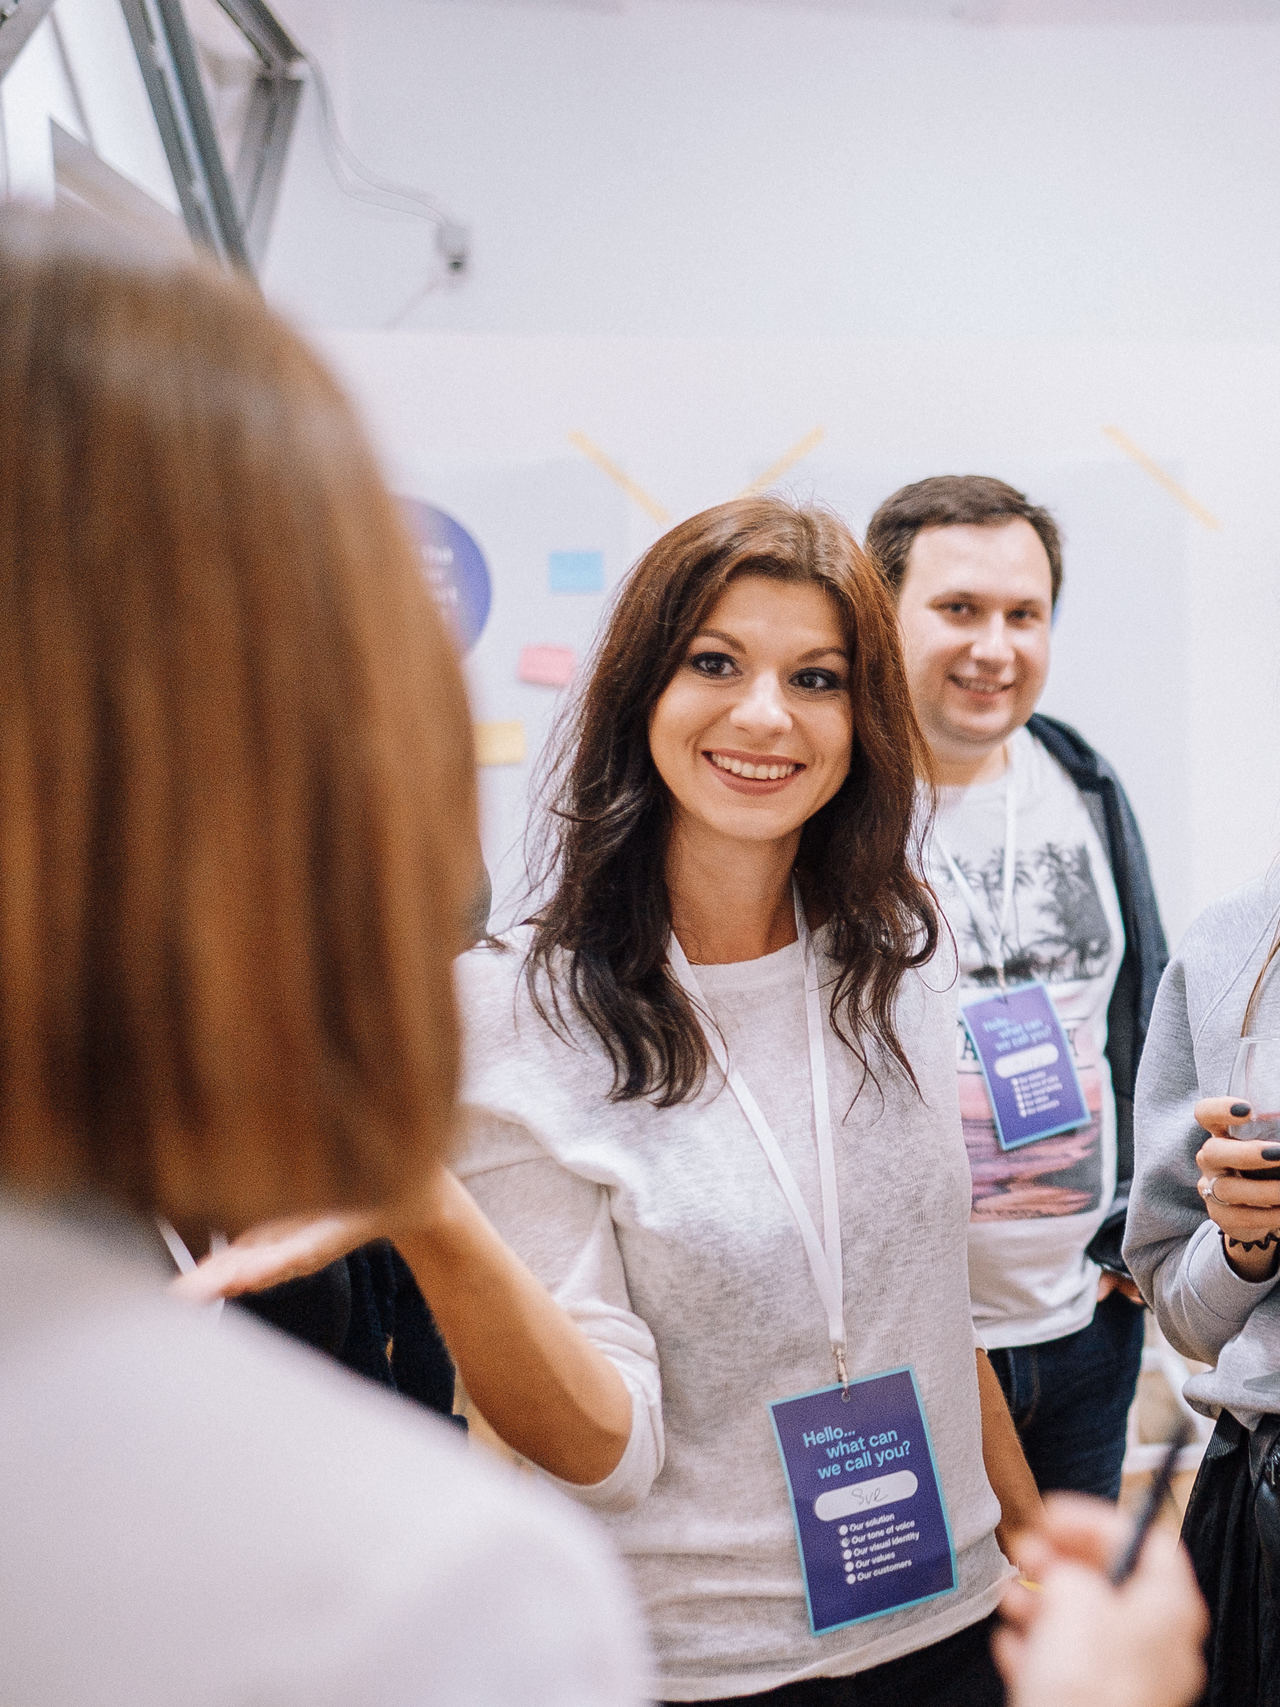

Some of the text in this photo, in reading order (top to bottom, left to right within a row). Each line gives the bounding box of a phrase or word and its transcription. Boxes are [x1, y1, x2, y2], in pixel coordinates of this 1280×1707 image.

[802, 1425, 856, 1448] Hello...
[826, 1430, 898, 1459] what can
[817, 1440, 910, 1480] we call you?
[849, 1522, 864, 1532] Our
[851, 1519, 915, 1545] Our tone of voice
[853, 1547, 868, 1557] Our
[855, 1559, 870, 1569] Our
[857, 1571, 872, 1581] Our
